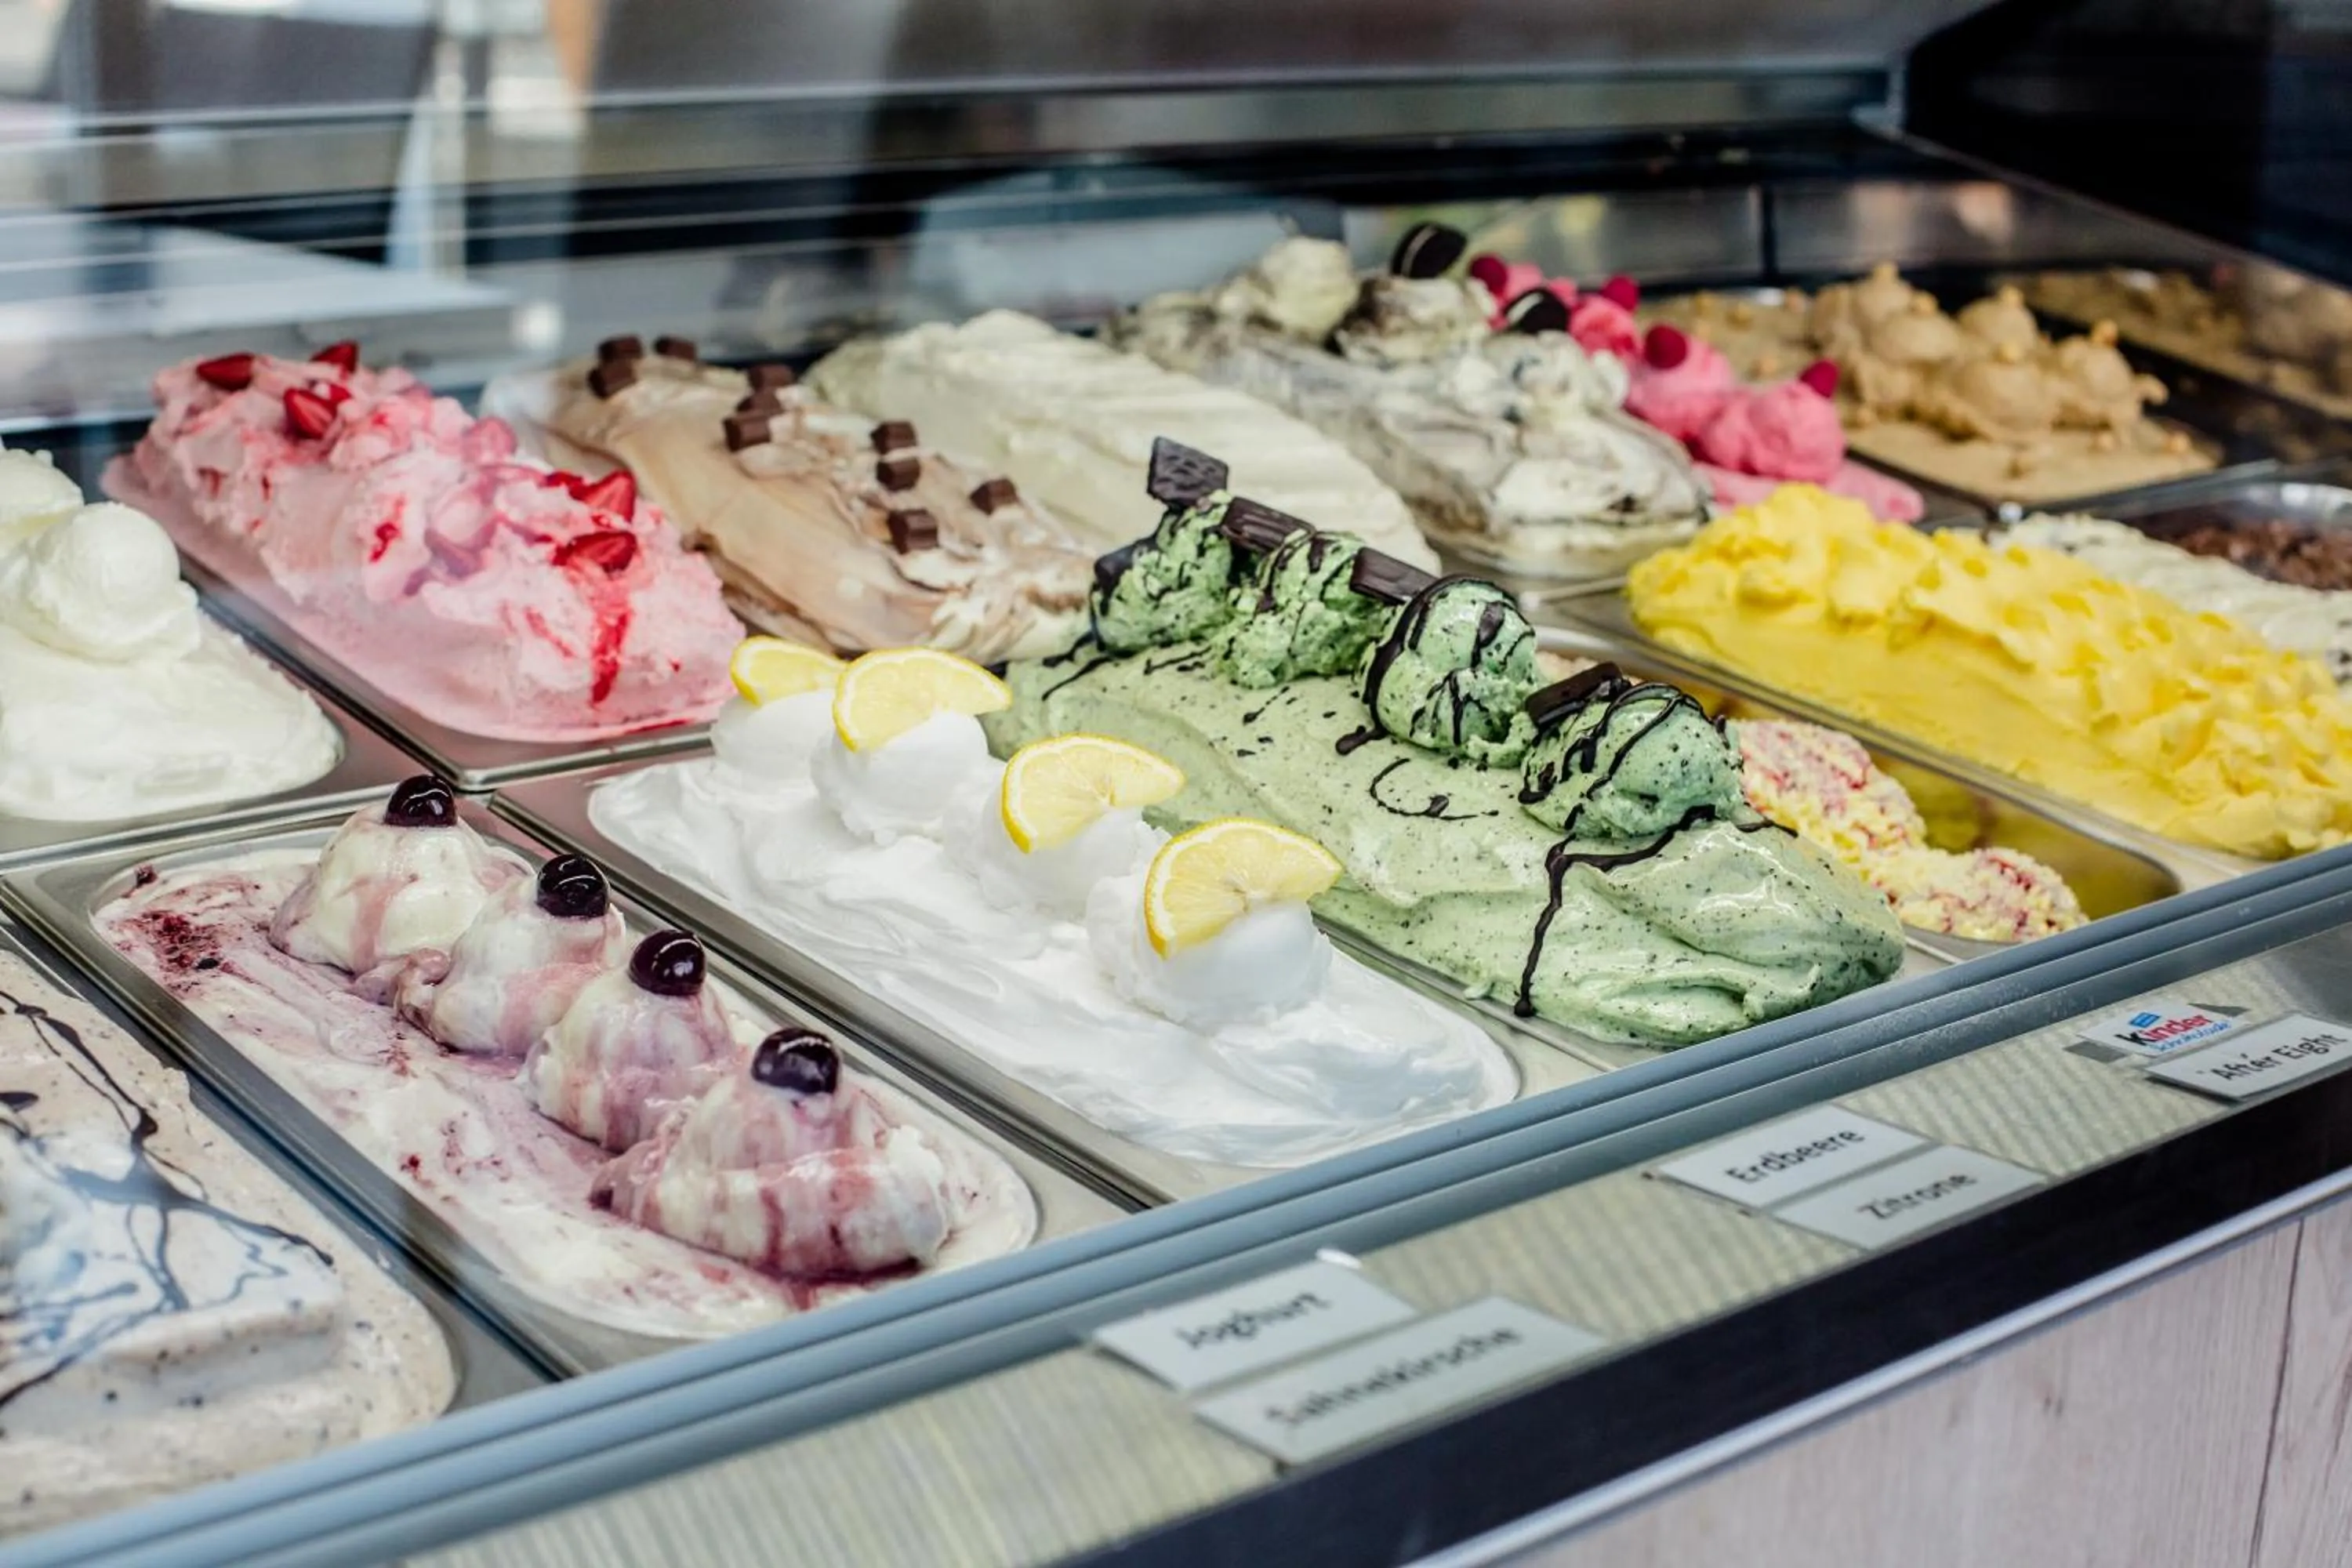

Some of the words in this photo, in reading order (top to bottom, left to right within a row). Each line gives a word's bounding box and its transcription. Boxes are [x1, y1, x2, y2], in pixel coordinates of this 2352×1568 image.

[2211, 1056, 2283, 1080] After
[2272, 1034, 2348, 1059] Eight
[1725, 1129, 1864, 1184] Erdbeere
[1856, 1173, 1977, 1220] Zitrone
